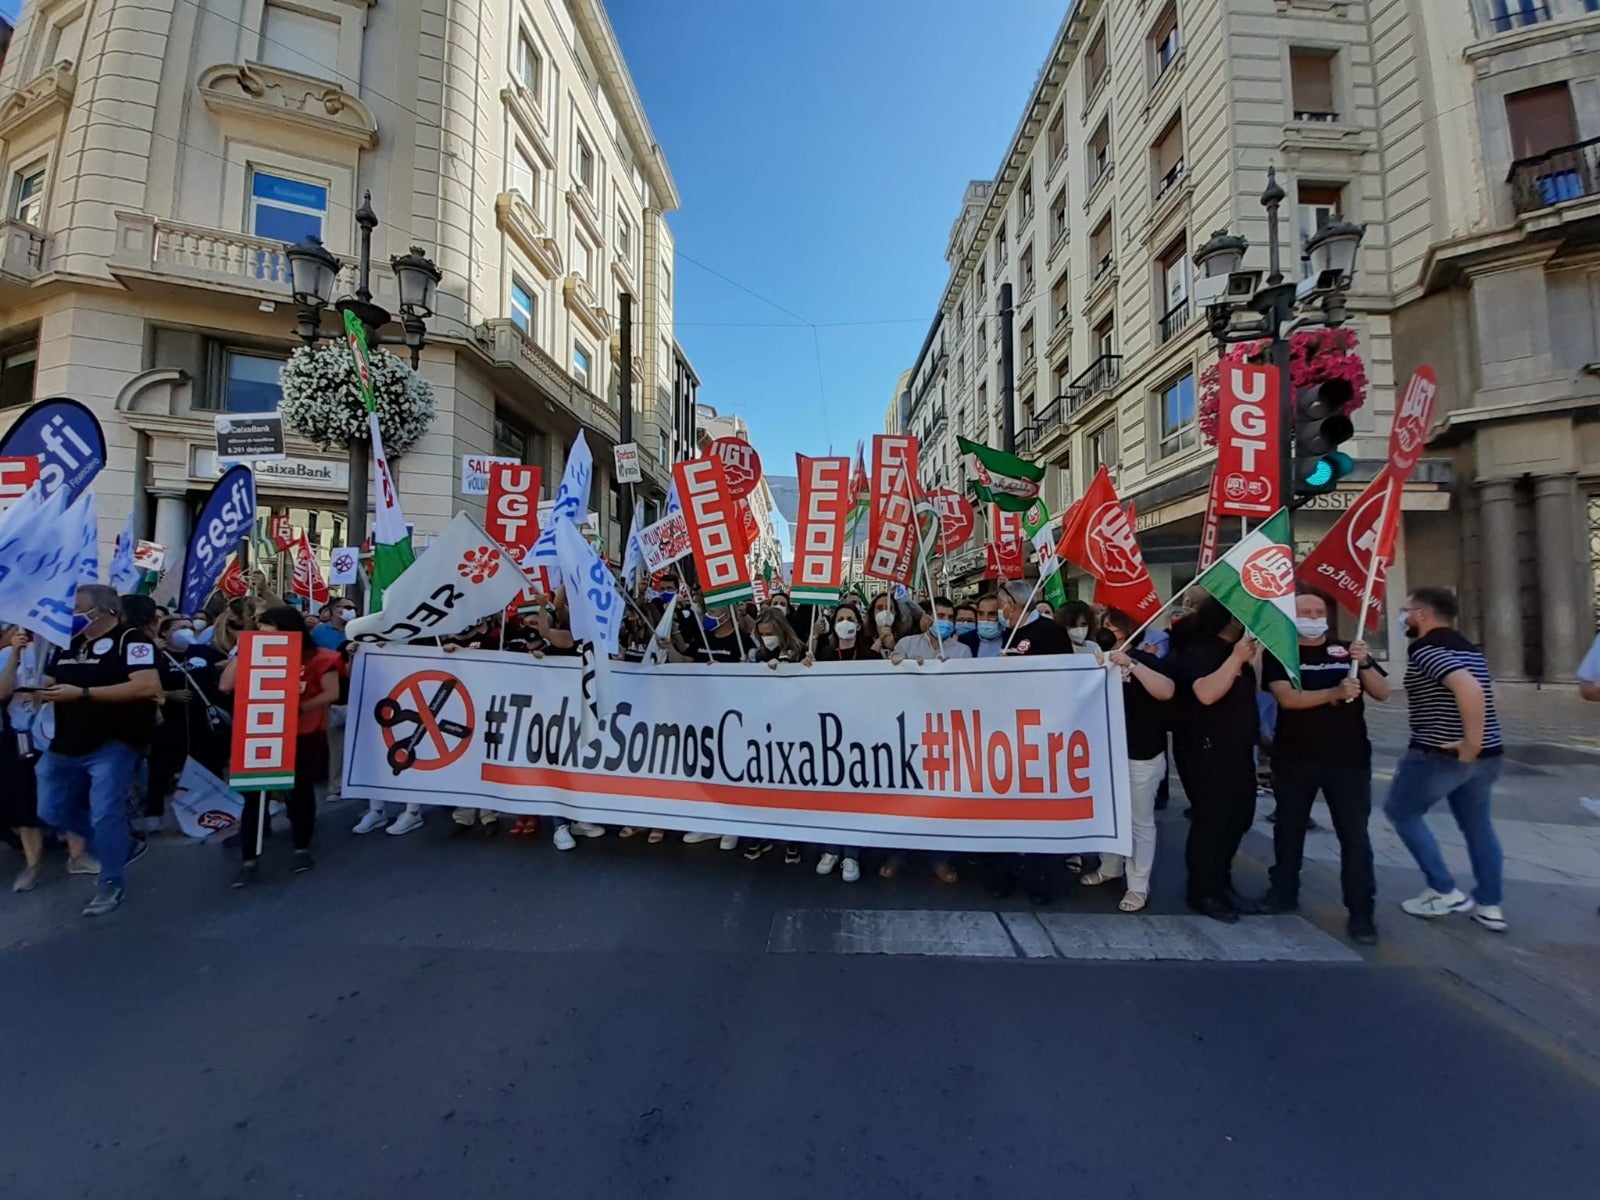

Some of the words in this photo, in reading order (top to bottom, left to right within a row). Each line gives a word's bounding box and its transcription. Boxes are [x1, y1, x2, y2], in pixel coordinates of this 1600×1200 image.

[1230, 368, 1267, 473] UGT
[254, 461, 333, 479] CaixaBank
[497, 469, 532, 542] UGT
[197, 478, 252, 567] sesfi
[683, 460, 740, 586] CCOO
[802, 460, 840, 584] CCOO
[1136, 511, 1162, 530] ELLI
[244, 635, 289, 769] CCOO
